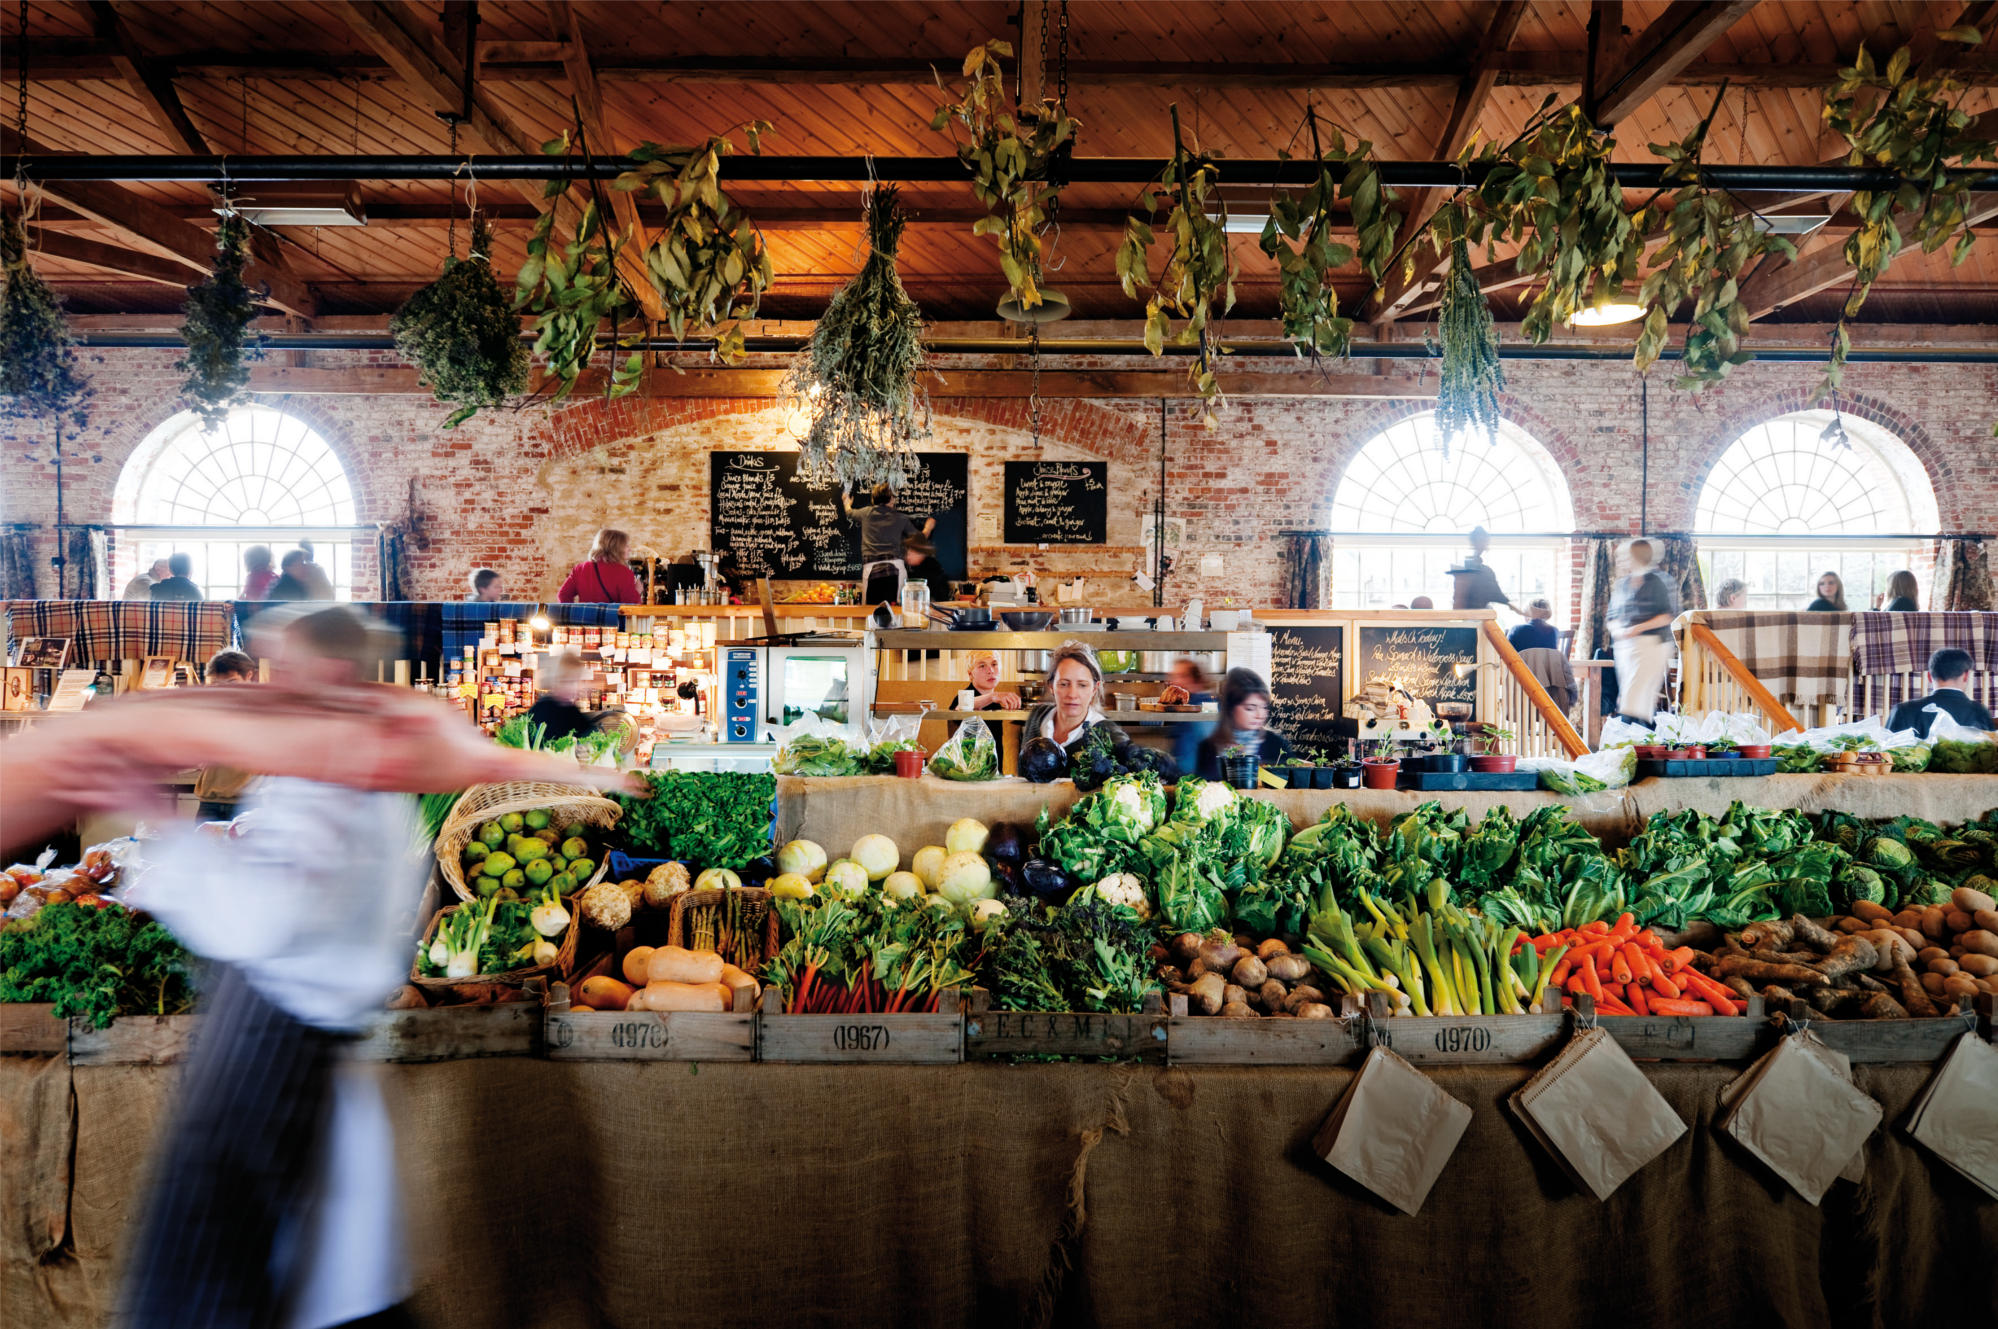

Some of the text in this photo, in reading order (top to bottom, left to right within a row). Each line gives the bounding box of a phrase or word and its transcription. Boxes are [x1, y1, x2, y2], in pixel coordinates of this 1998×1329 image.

[1033, 462, 1079, 477] Juice Blends
[723, 472, 741, 482] Juice
[742, 472, 763, 484] Blends
[1045, 481, 1068, 489] orange
[1417, 628, 1447, 649] Today!
[1455, 649, 1475, 663] Soup
[833, 1025, 891, 1051] (1967)
[1434, 1027, 1492, 1053] (1970)
